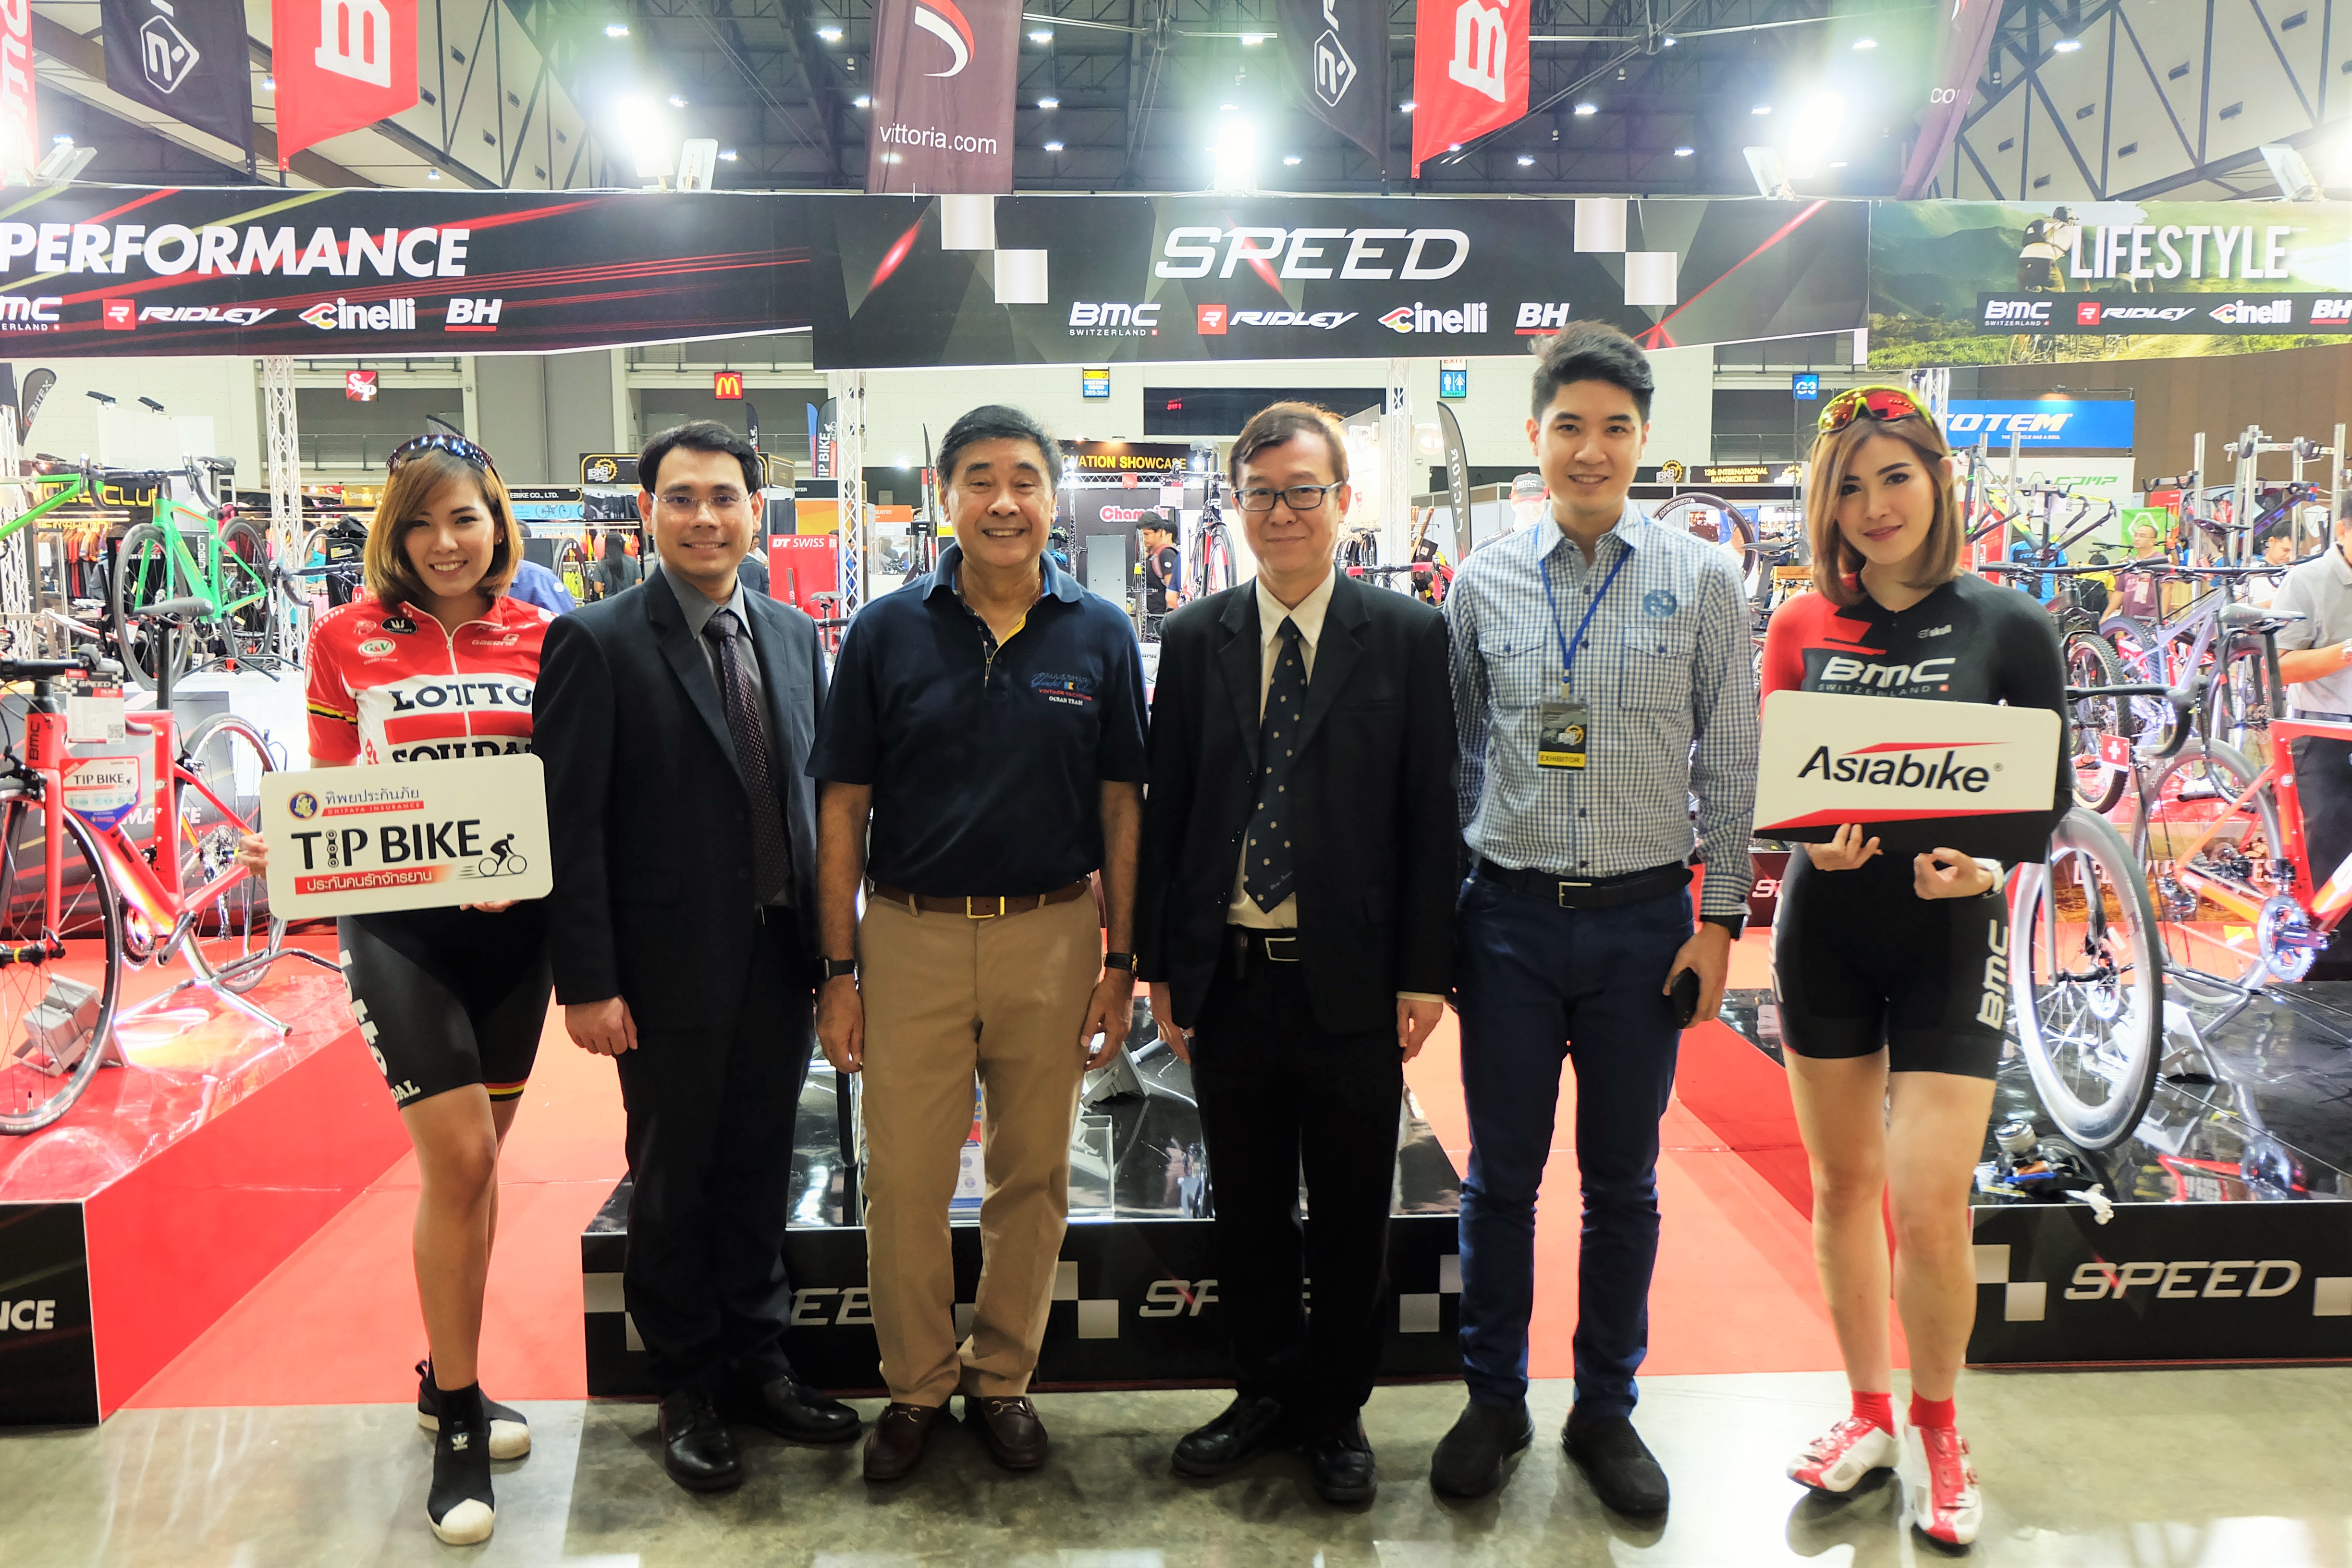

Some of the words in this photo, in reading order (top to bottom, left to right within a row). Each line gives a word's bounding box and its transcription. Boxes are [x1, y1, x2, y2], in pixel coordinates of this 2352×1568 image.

[880, 124, 997, 155] vittoria.com
[0, 223, 470, 277] PERFORMANCE
[1155, 227, 1470, 280] SPEED
[2070, 226, 2290, 279] LIFESTYLE
[139, 306, 278, 326] RIDLEY
[299, 298, 415, 330] Cinelli
[445, 298, 502, 323] BH
[1069, 302, 1161, 326] BMC
[1229, 311, 1359, 330] RIDLEY
[1378, 302, 1487, 333] Cinelli
[1516, 303, 1570, 327] BH
[1984, 300, 2052, 320] BMC
[2100, 307, 2195, 321] RIDLEY
[2208, 299, 2291, 324] Cinelli
[2311, 299, 2352, 318] BH
[1796, 381, 1816, 394] G3
[26, 379, 53, 423] BITEX
[1947, 414, 2070, 431] OTEM
[819, 432, 830, 462] BIKE
[819, 464, 829, 478] IP
[1717, 467, 1768, 476] INTERNATIONAL
[1102, 507, 1159, 520] Chami
[772, 538, 791, 547] DT
[793, 538, 825, 547] SWISS
[364, 642, 389, 651] G&V
[1821, 657, 1956, 688] BMC
[389, 682, 532, 711] LOTTO
[1068, 698, 1083, 706] TEAM
[29, 721, 40, 760] BMC
[1540, 755, 1580, 763] EXHIBITOR
[1798, 746, 1990, 792] Asiabike
[73, 774, 94, 785] TIP
[97, 773, 124, 784] BIKE
[325, 785, 419, 805] ทิพยประกันภัย
[328, 806, 366, 815] DHIPAYA
[369, 803, 421, 812] INSURANCE
[380, 819, 483, 863] BIKE
[1976, 919, 2009, 1030] BMC
[2064, 1259, 2302, 1300] SPEED
